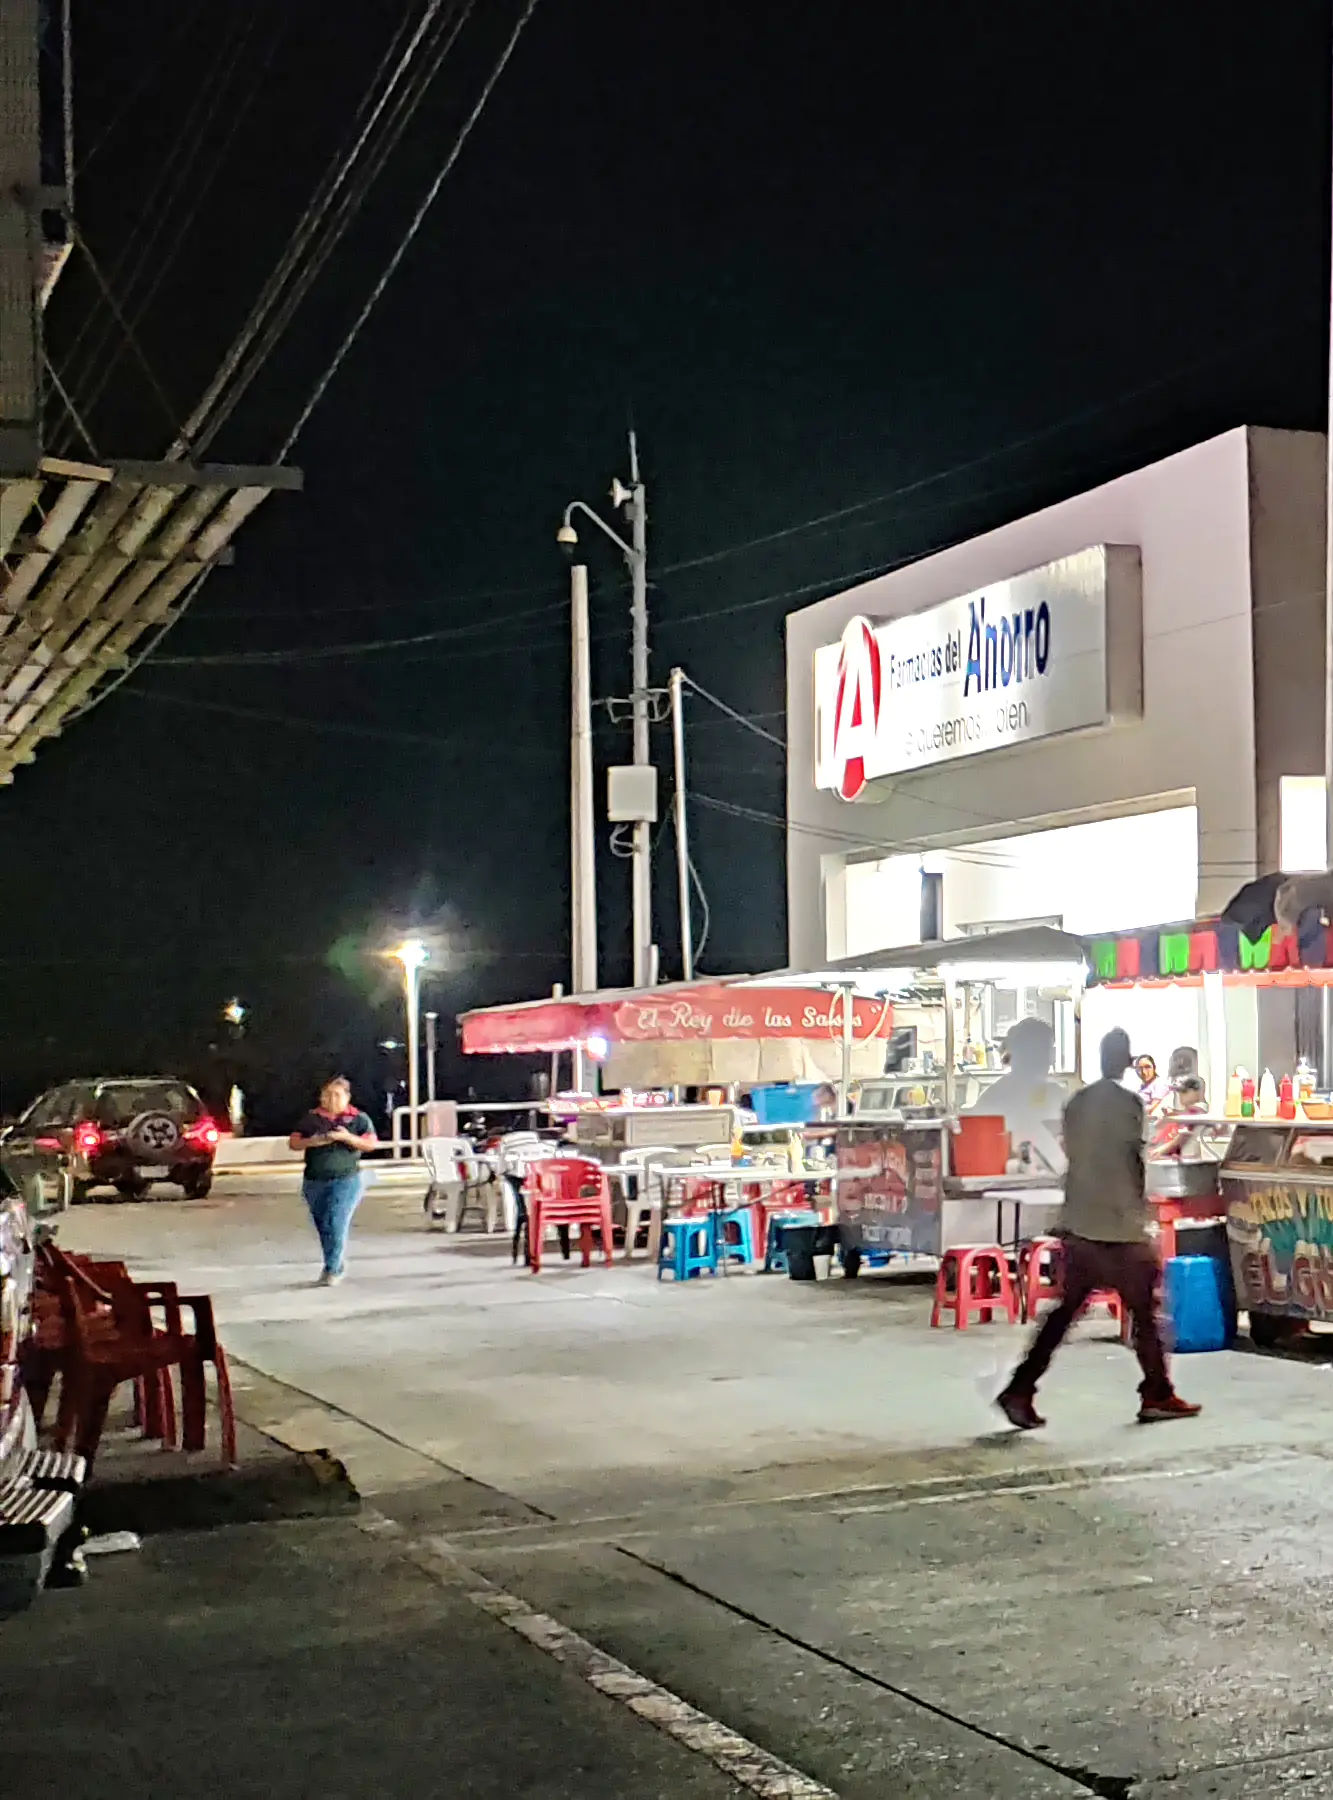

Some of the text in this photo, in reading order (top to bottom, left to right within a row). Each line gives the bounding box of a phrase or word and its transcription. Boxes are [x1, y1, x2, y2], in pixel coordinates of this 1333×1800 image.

[891, 596, 1050, 698] Farmacias del Ahorro
[669, 1001, 713, 1035] Rey
[764, 1006, 792, 1028] las
